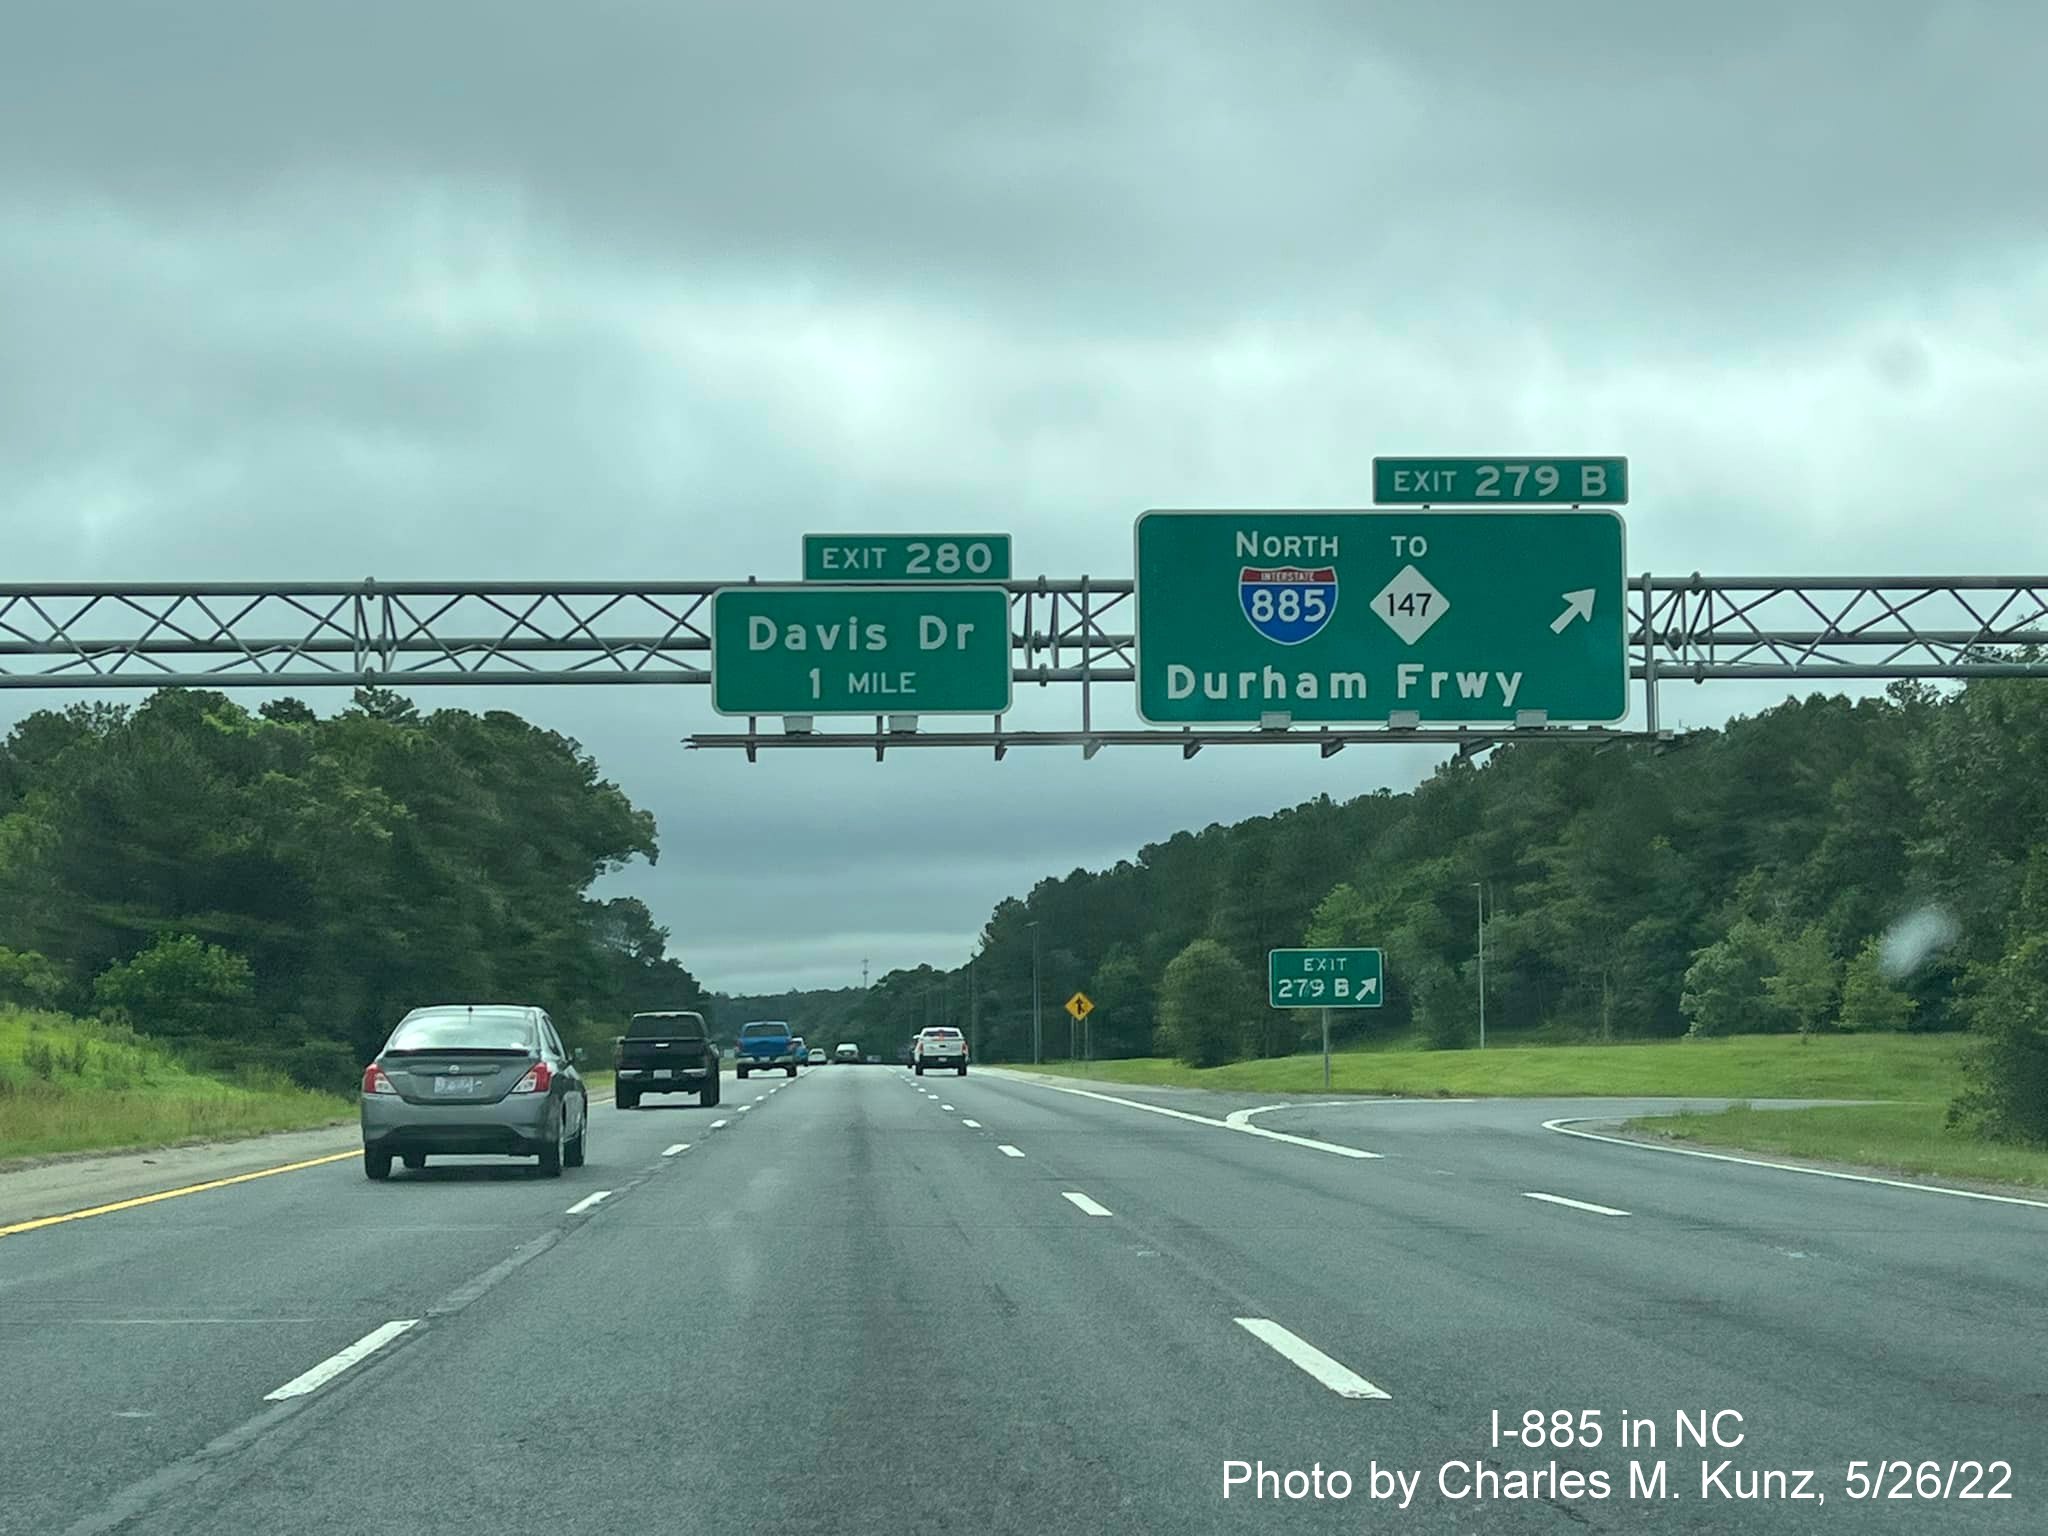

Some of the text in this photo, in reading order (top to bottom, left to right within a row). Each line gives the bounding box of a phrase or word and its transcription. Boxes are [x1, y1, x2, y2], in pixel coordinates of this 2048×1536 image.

[1394, 465, 1607, 497] EXIT 279 B
[822, 542, 993, 574] EXIT 280
[1236, 530, 1339, 558] NORTH
[1390, 535, 1428, 557] TO
[1260, 571, 1315, 582] INTERSTATE
[1251, 588, 1327, 623] 885
[1386, 593, 1432, 617] 147
[748, 615, 975, 651] Davis Dr
[808, 667, 916, 699] 1 MILE
[1167, 663, 1523, 708] Durham Frwy
[1303, 957, 1347, 972] EXIT
[1278, 977, 1350, 998] 279 B
